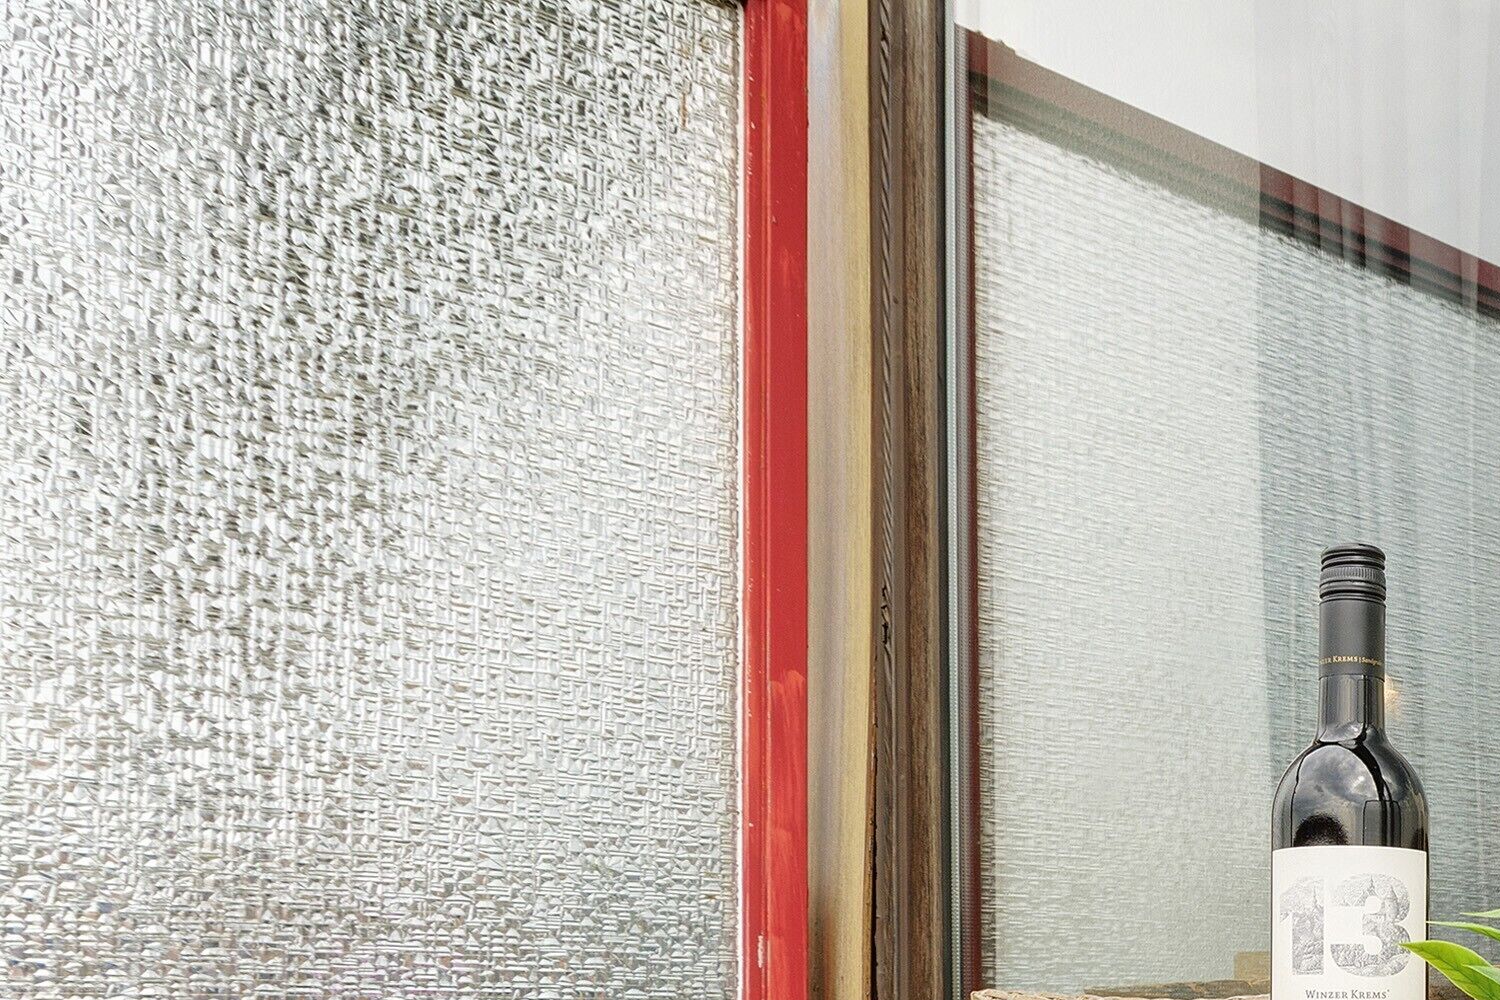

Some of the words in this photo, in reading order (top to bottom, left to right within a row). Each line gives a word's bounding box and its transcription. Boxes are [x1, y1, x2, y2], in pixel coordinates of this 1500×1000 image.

[1332, 655, 1358, 663] KREMS
[1279, 872, 1412, 977] 13
[1305, 989, 1348, 999] WINZER
